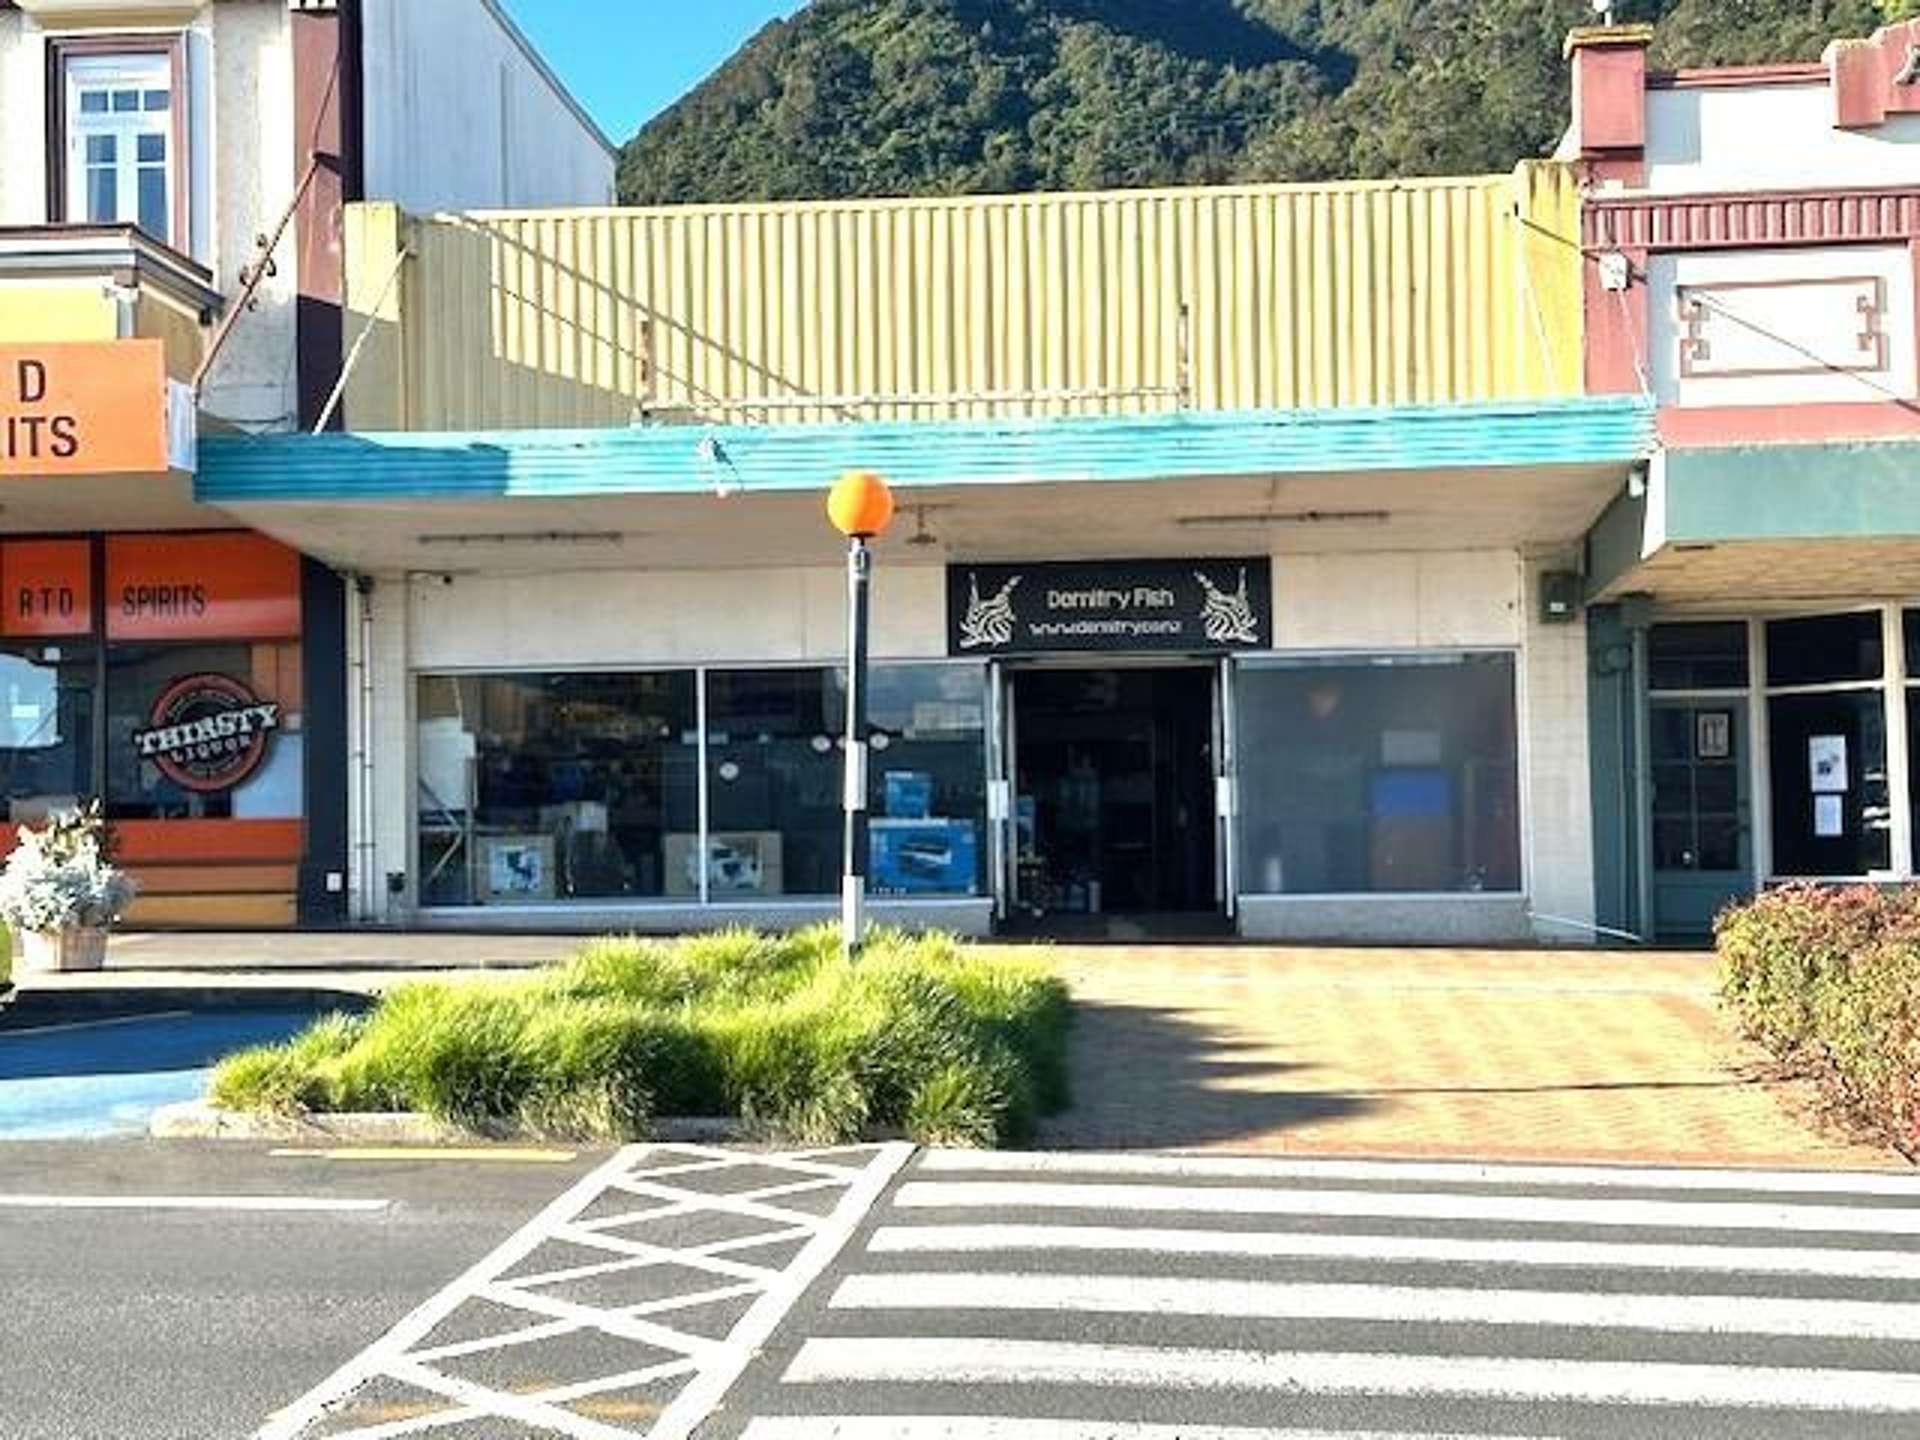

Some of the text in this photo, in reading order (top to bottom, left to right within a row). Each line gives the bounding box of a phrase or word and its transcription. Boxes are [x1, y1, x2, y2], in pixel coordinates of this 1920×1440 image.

[18, 359, 46, 402] D
[0, 416, 79, 457] ITS
[122, 583, 206, 616] SPIRITS
[1133, 587, 1175, 606] Fish
[134, 704, 277, 754] THIRSTY
[169, 735, 250, 763] LIQUOR
